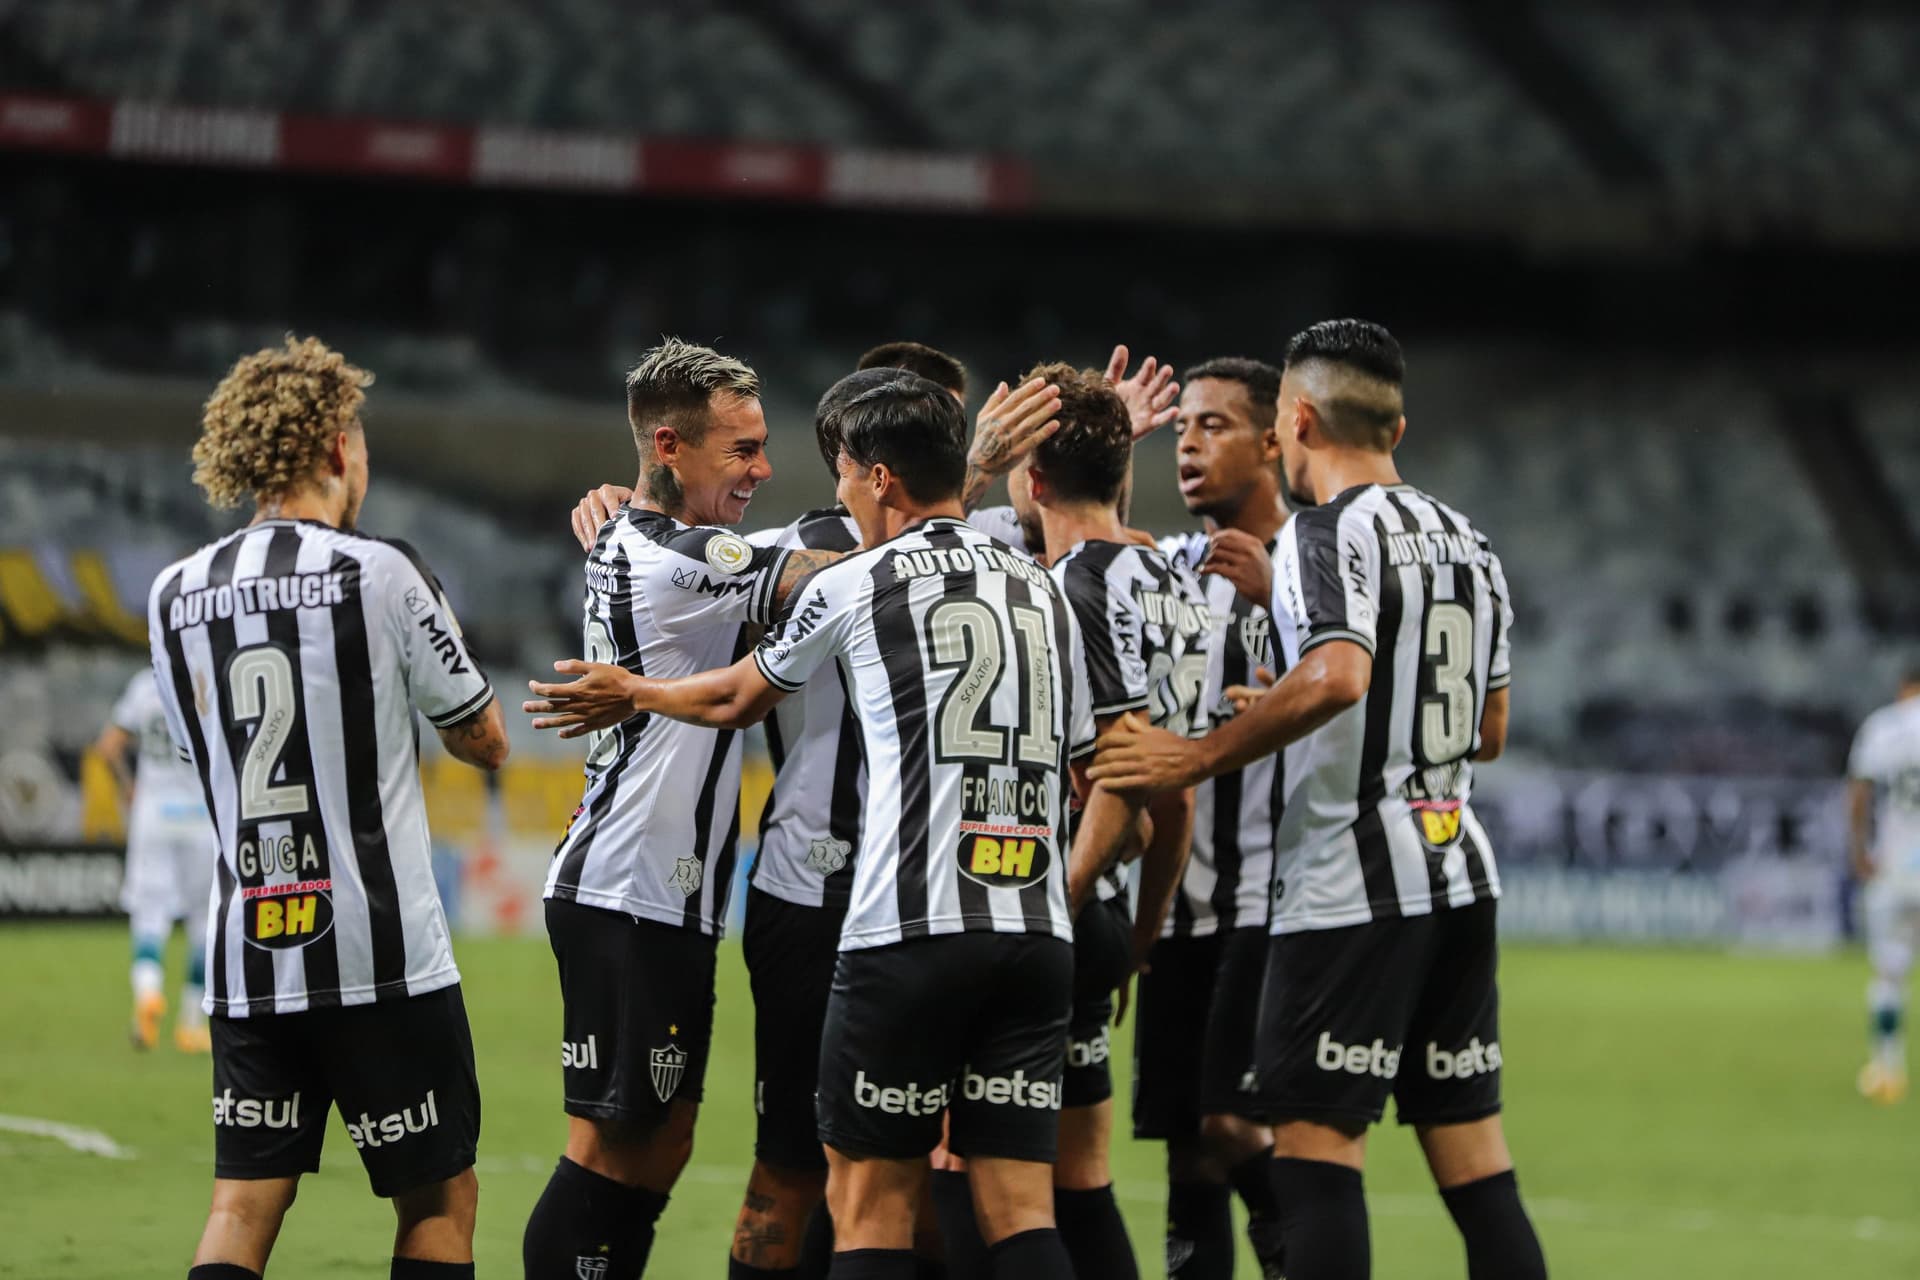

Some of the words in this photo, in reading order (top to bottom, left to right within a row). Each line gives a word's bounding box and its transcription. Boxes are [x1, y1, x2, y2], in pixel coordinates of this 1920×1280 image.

[1386, 530, 1431, 566] AUTO
[893, 548, 974, 583] AUTO
[975, 545, 1057, 599] TRUCK
[170, 584, 234, 631] AUTO
[238, 572, 343, 614] TRUCK
[790, 588, 829, 643] MRV
[419, 613, 470, 674] MRV
[929, 601, 1058, 768] 21
[960, 656, 993, 704] SOLATIO
[1422, 602, 1474, 764] 3
[228, 646, 309, 820] 2
[255, 709, 285, 761] SOLATIO
[961, 777, 1049, 817] FRANCO
[960, 822, 1052, 837] SUPERMERCADOS
[239, 833, 319, 878] GUGA
[971, 836, 1036, 877] BH
[242, 879, 333, 899] UPERMERCADOS
[256, 895, 317, 940] BH
[562, 1034, 598, 1069] sul
[1316, 1031, 1402, 1079] bets
[1426, 1036, 1503, 1080] bets
[212, 1088, 300, 1128] etsul
[963, 1064, 1063, 1110] betsu
[347, 1089, 439, 1149] etsul
